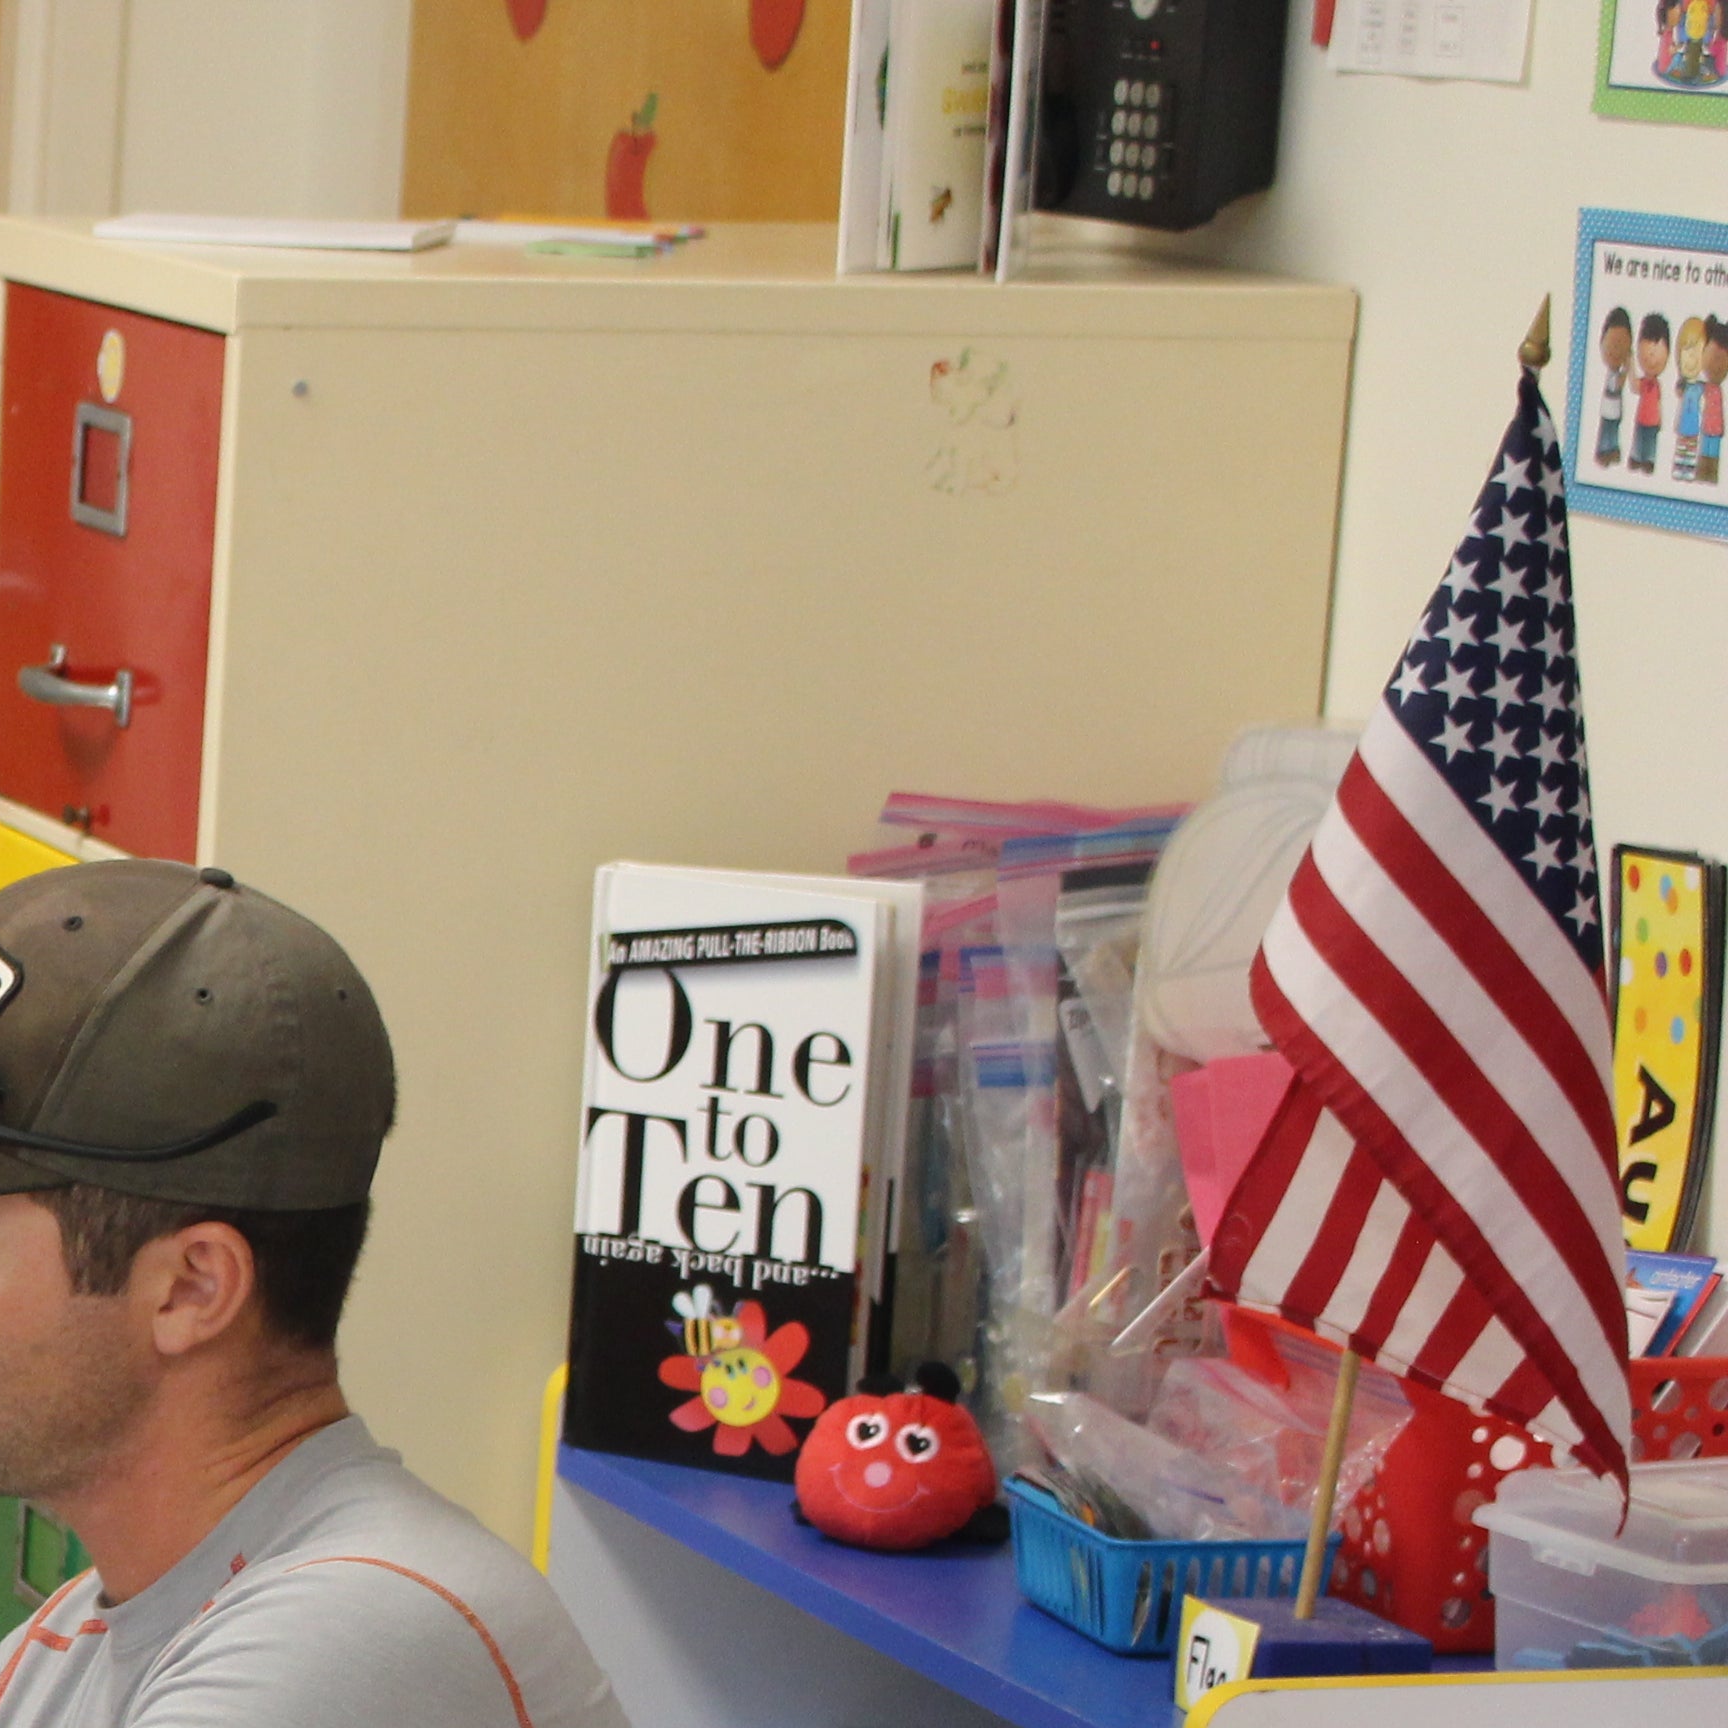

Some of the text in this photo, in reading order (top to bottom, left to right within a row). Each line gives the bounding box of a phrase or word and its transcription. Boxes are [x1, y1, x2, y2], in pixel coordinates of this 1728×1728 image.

[1604, 252, 1622, 275] We
[1627, 258, 1649, 278] are
[1652, 258, 1681, 281] nice
[1686, 260, 1700, 284] to
[628, 934, 696, 963] AMAZING
[696, 928, 816, 959] PULL-THE-RIBBON
[820, 924, 855, 950] Book
[595, 966, 854, 1108] One
[698, 1096, 780, 1168] to
[584, 1106, 826, 1268] Ten
[582, 1231, 663, 1267] again
[671, 1247, 745, 1288] back
